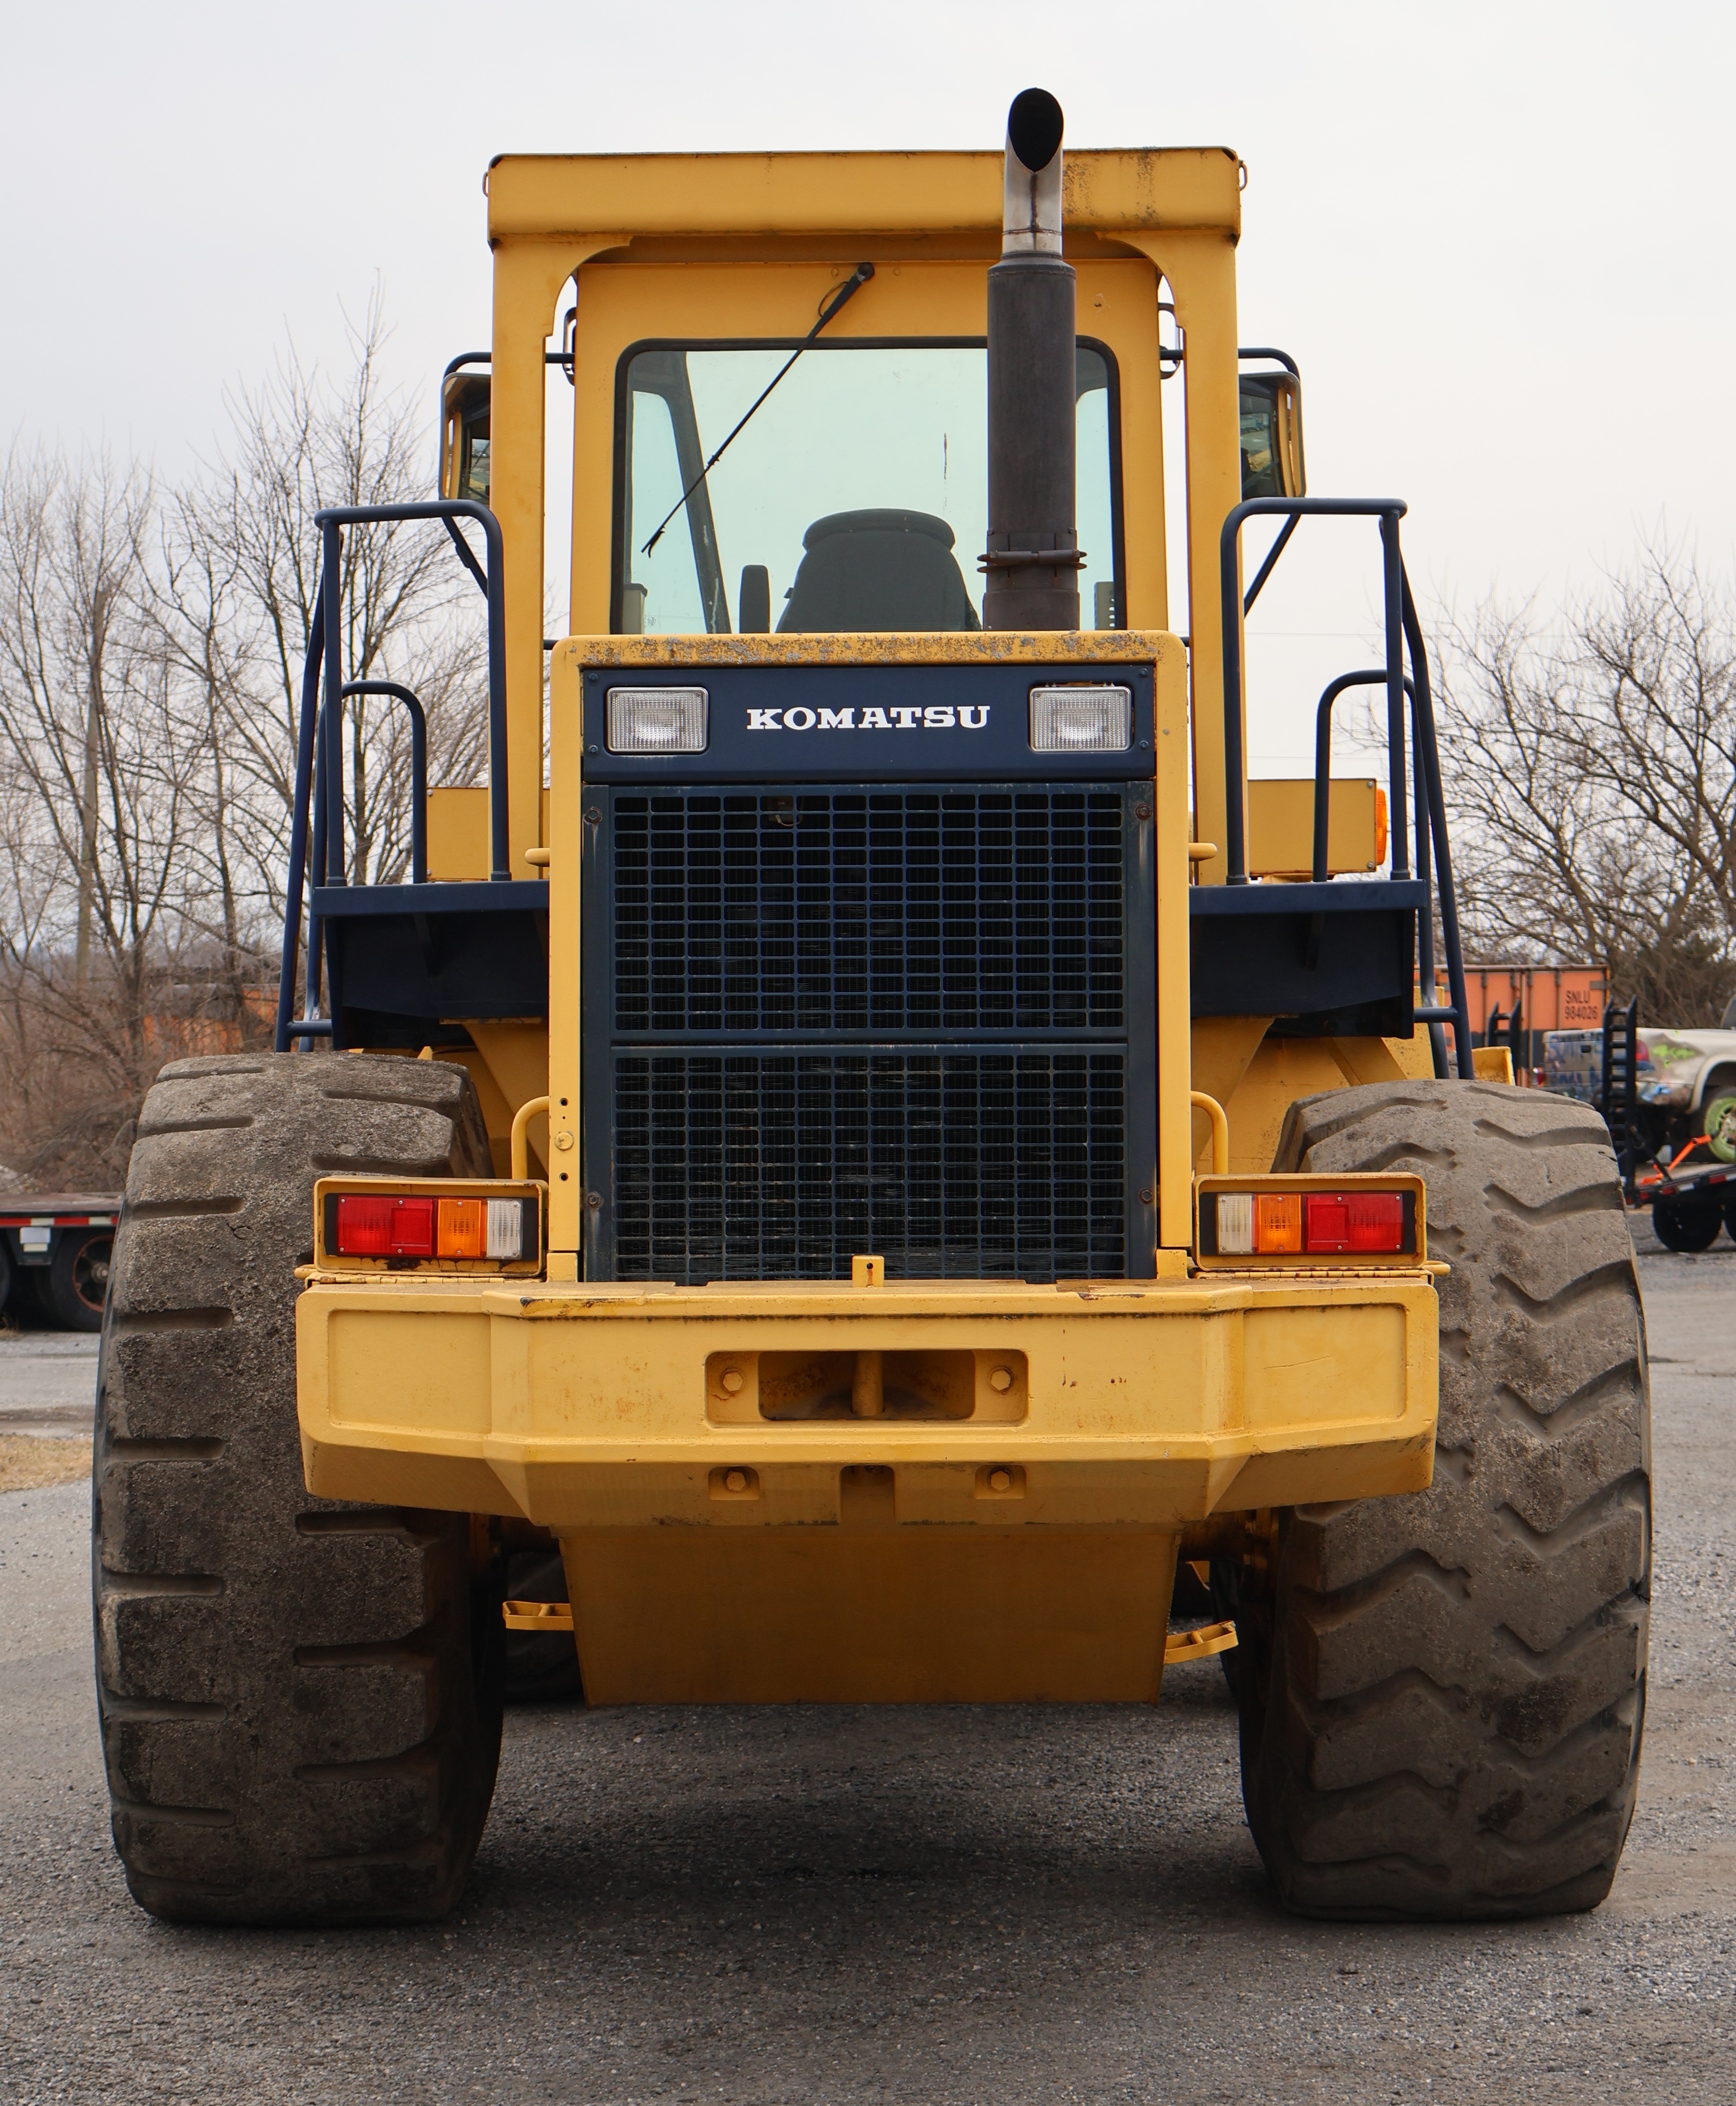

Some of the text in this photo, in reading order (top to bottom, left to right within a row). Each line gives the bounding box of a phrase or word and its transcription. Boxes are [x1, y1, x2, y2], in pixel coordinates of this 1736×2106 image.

[746, 706, 990, 730] KOMATSU
[1566, 990, 1590, 1003] SNLU
[1565, 1006, 1598, 1019] 984026
